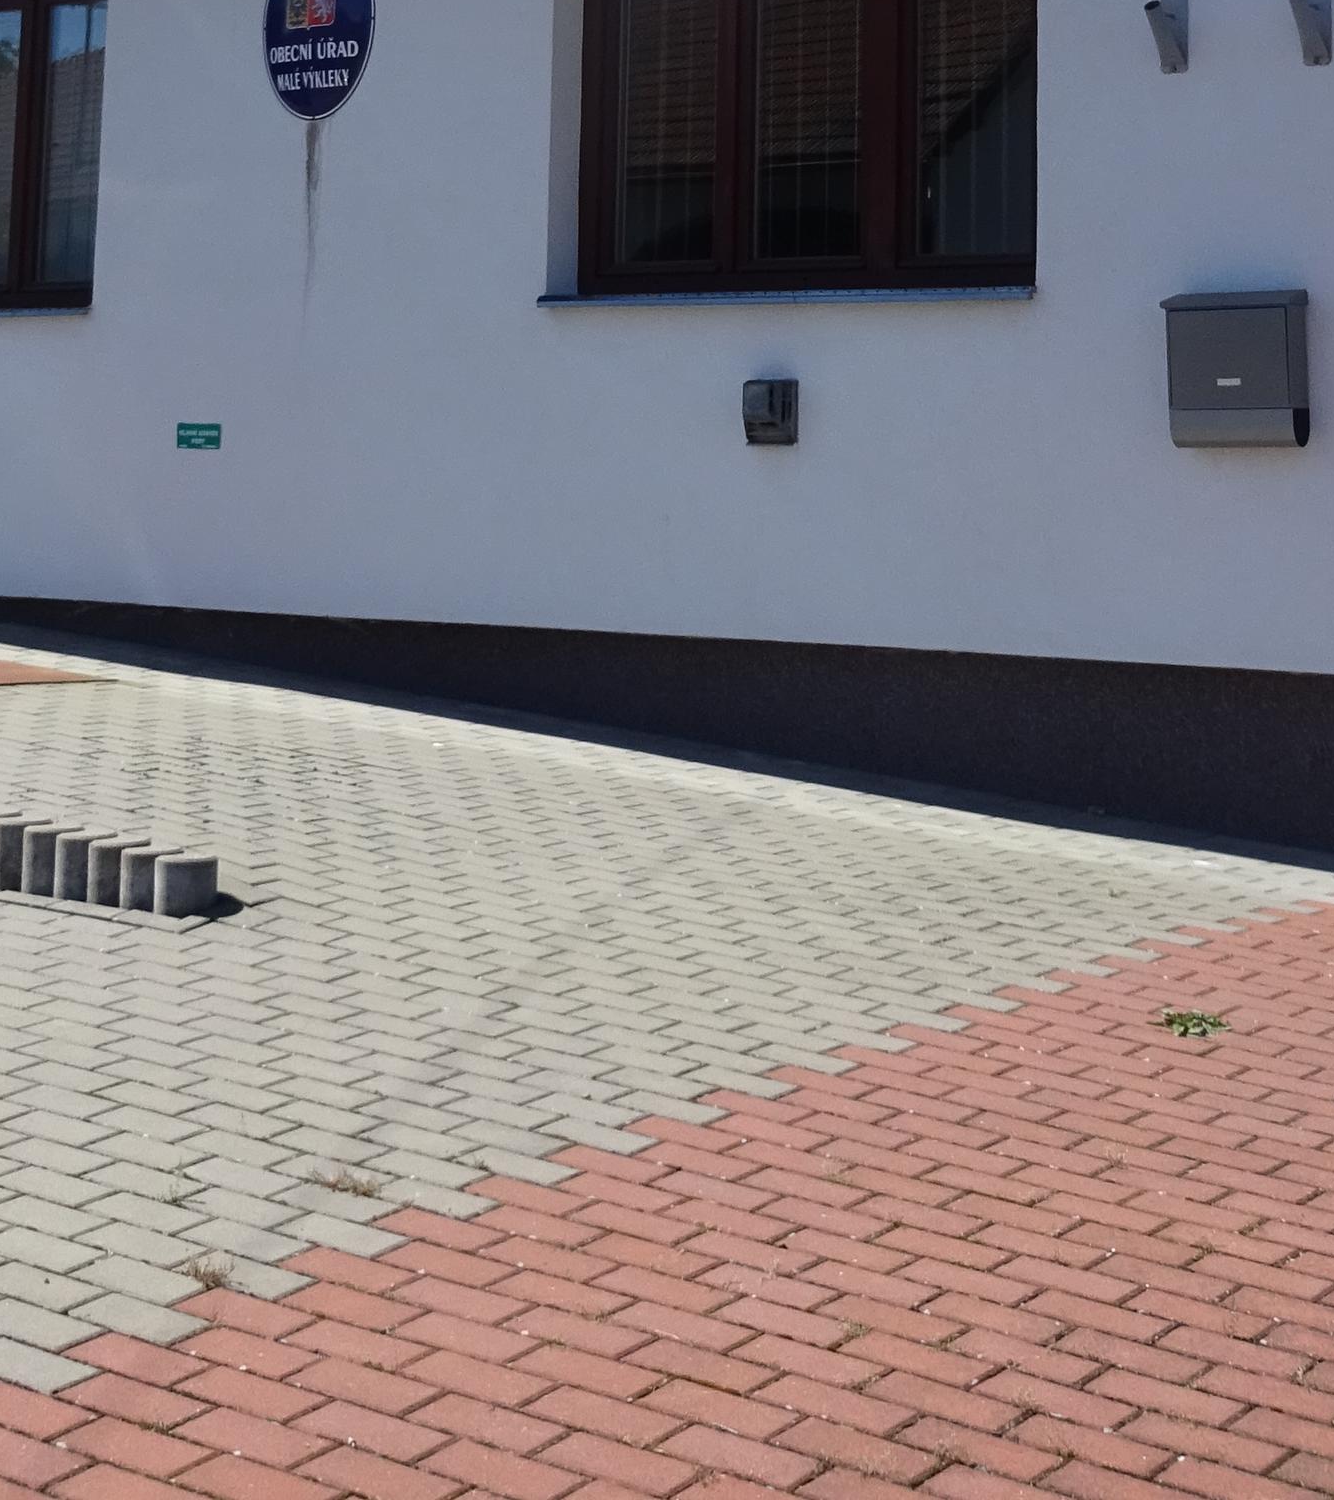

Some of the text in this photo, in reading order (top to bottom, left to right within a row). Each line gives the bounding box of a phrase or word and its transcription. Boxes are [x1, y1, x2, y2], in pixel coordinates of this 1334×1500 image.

[270, 37, 359, 64] OBECNÍ ÚŘAD
[277, 65, 349, 91] MALÉ VÝKLEKY
